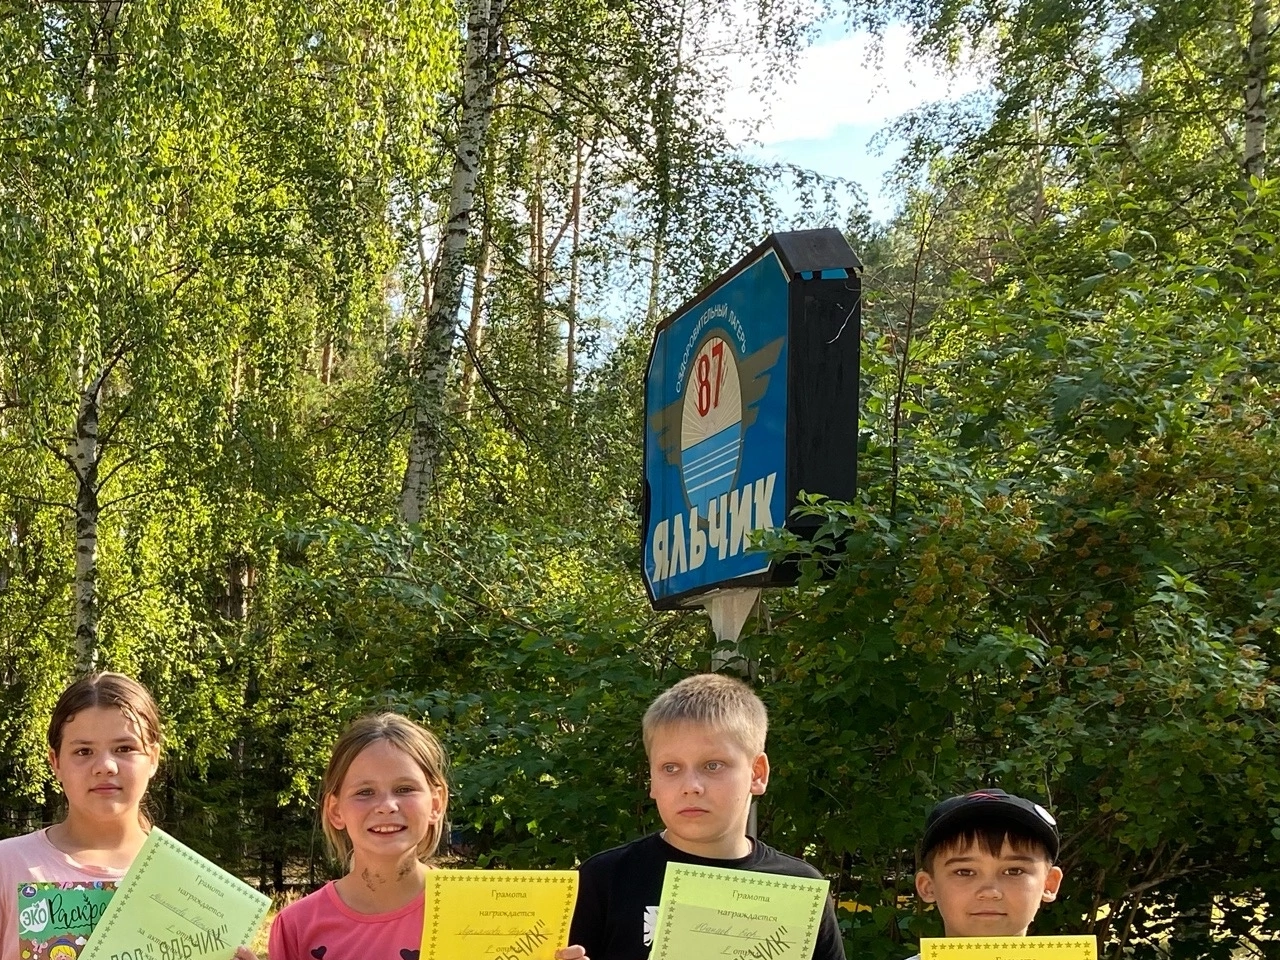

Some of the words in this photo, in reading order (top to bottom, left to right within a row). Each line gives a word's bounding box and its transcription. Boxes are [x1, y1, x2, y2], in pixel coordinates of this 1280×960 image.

[676, 303, 728, 393] ОЗДОРОВИТЕЛЬНЫЙ
[729, 311, 746, 353] ЛАГЕРЬ
[697, 341, 723, 417] 87
[652, 472, 777, 583] ЯЛЬЧИК
[194, 874, 225, 898] Грамота
[491, 890, 527, 901] Грамота
[732, 890, 771, 903] Грамота
[22, 902, 47, 926] ЭКО
[177, 886, 225, 919] награждается
[479, 908, 536, 919] награждается
[717, 909, 778, 923] награждается
[137, 928, 145, 936] за
